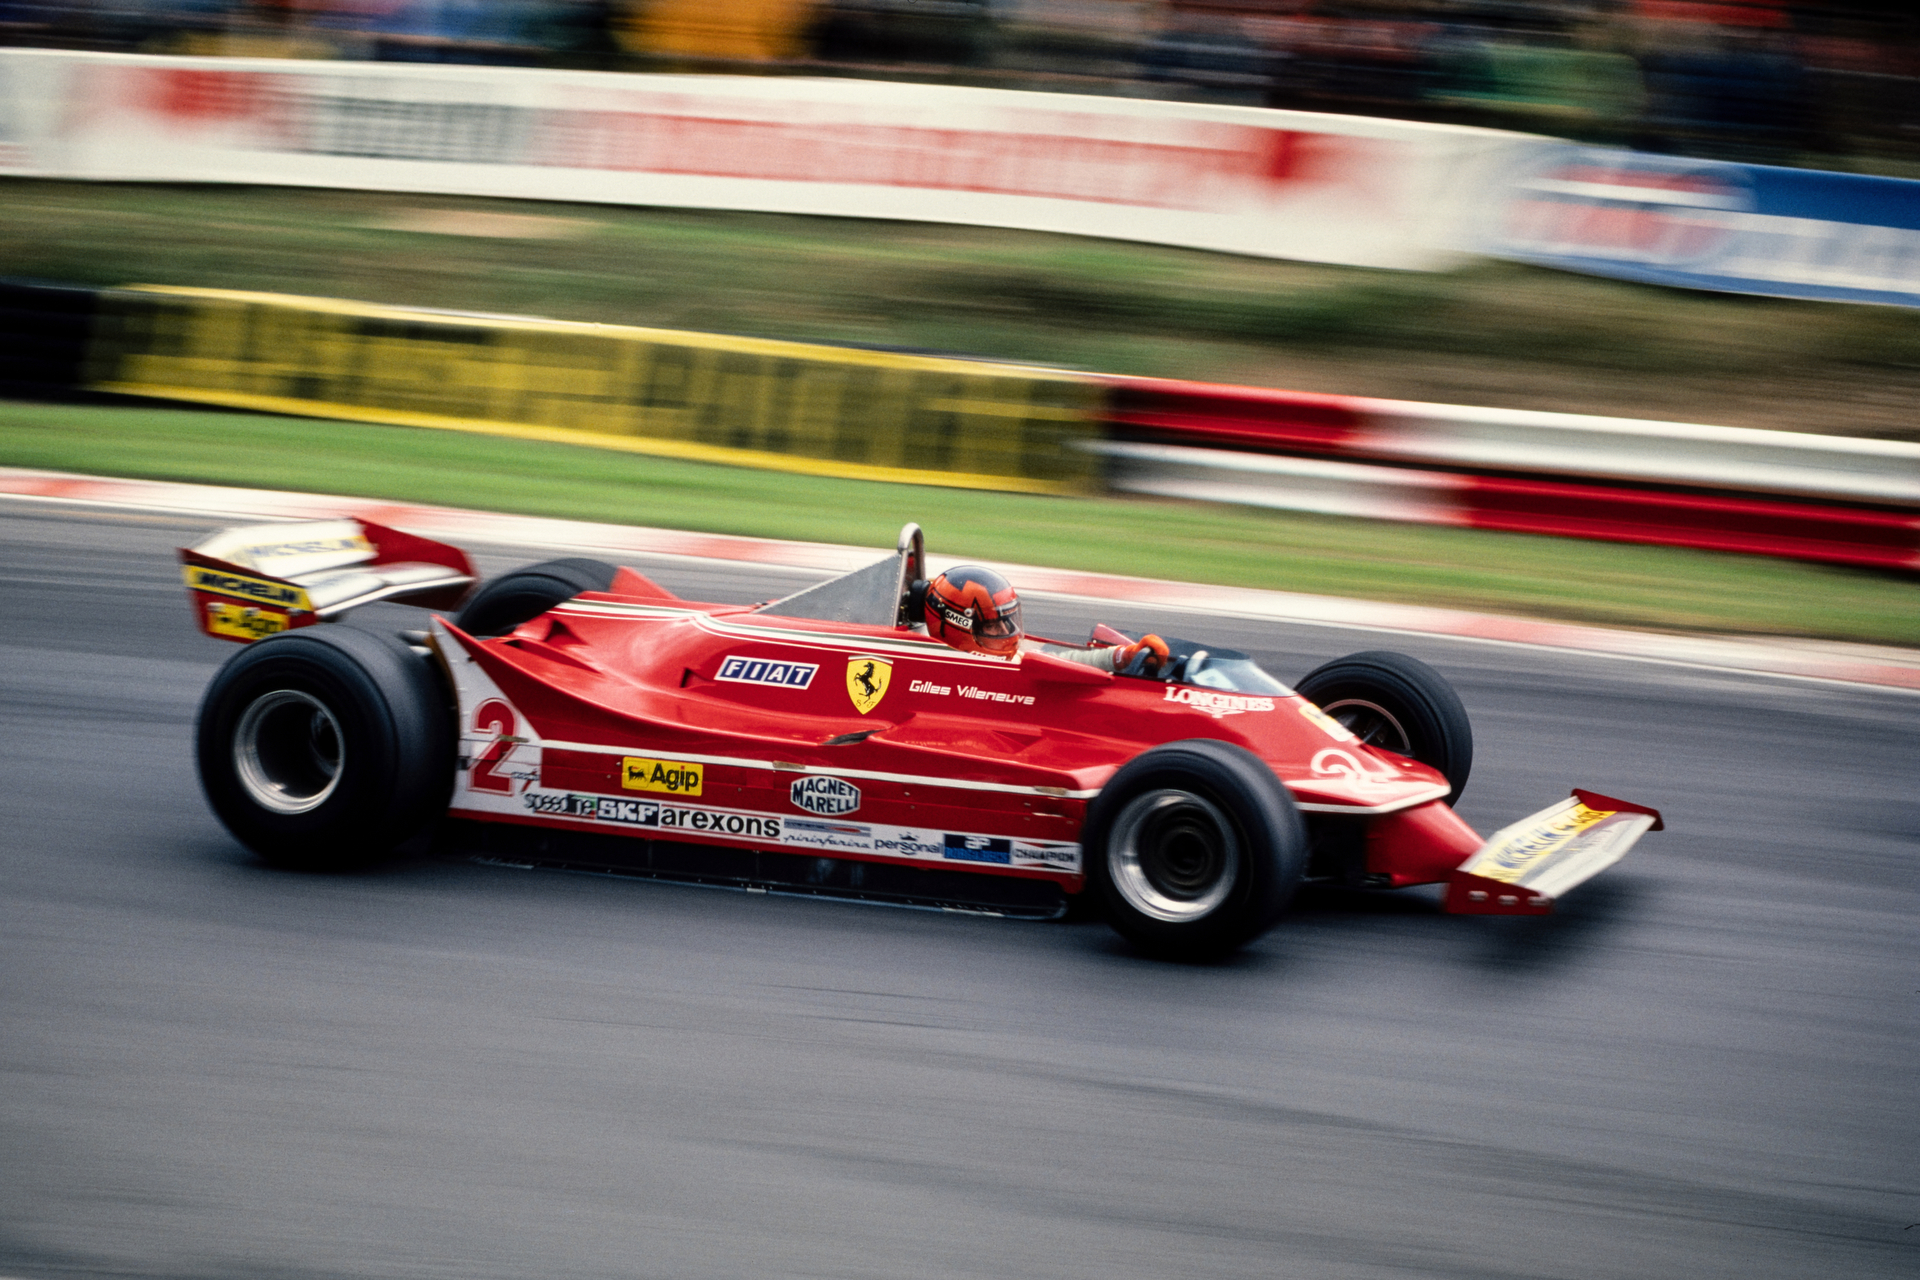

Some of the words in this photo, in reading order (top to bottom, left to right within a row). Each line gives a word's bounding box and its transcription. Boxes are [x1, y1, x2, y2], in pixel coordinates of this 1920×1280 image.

[945, 610, 970, 627] SMEG
[724, 660, 813, 685] FIAT
[909, 680, 951, 695] Gilles
[957, 685, 1035, 705] Villeneuve
[1164, 687, 1275, 711] LONGINES
[467, 698, 517, 797] 2
[650, 763, 699, 791] Agip
[793, 778, 859, 801] MAGNETI
[793, 790, 859, 813] MARELLI
[598, 800, 658, 821] SKF
[661, 808, 780, 837] arexons
[875, 838, 944, 855] personal
